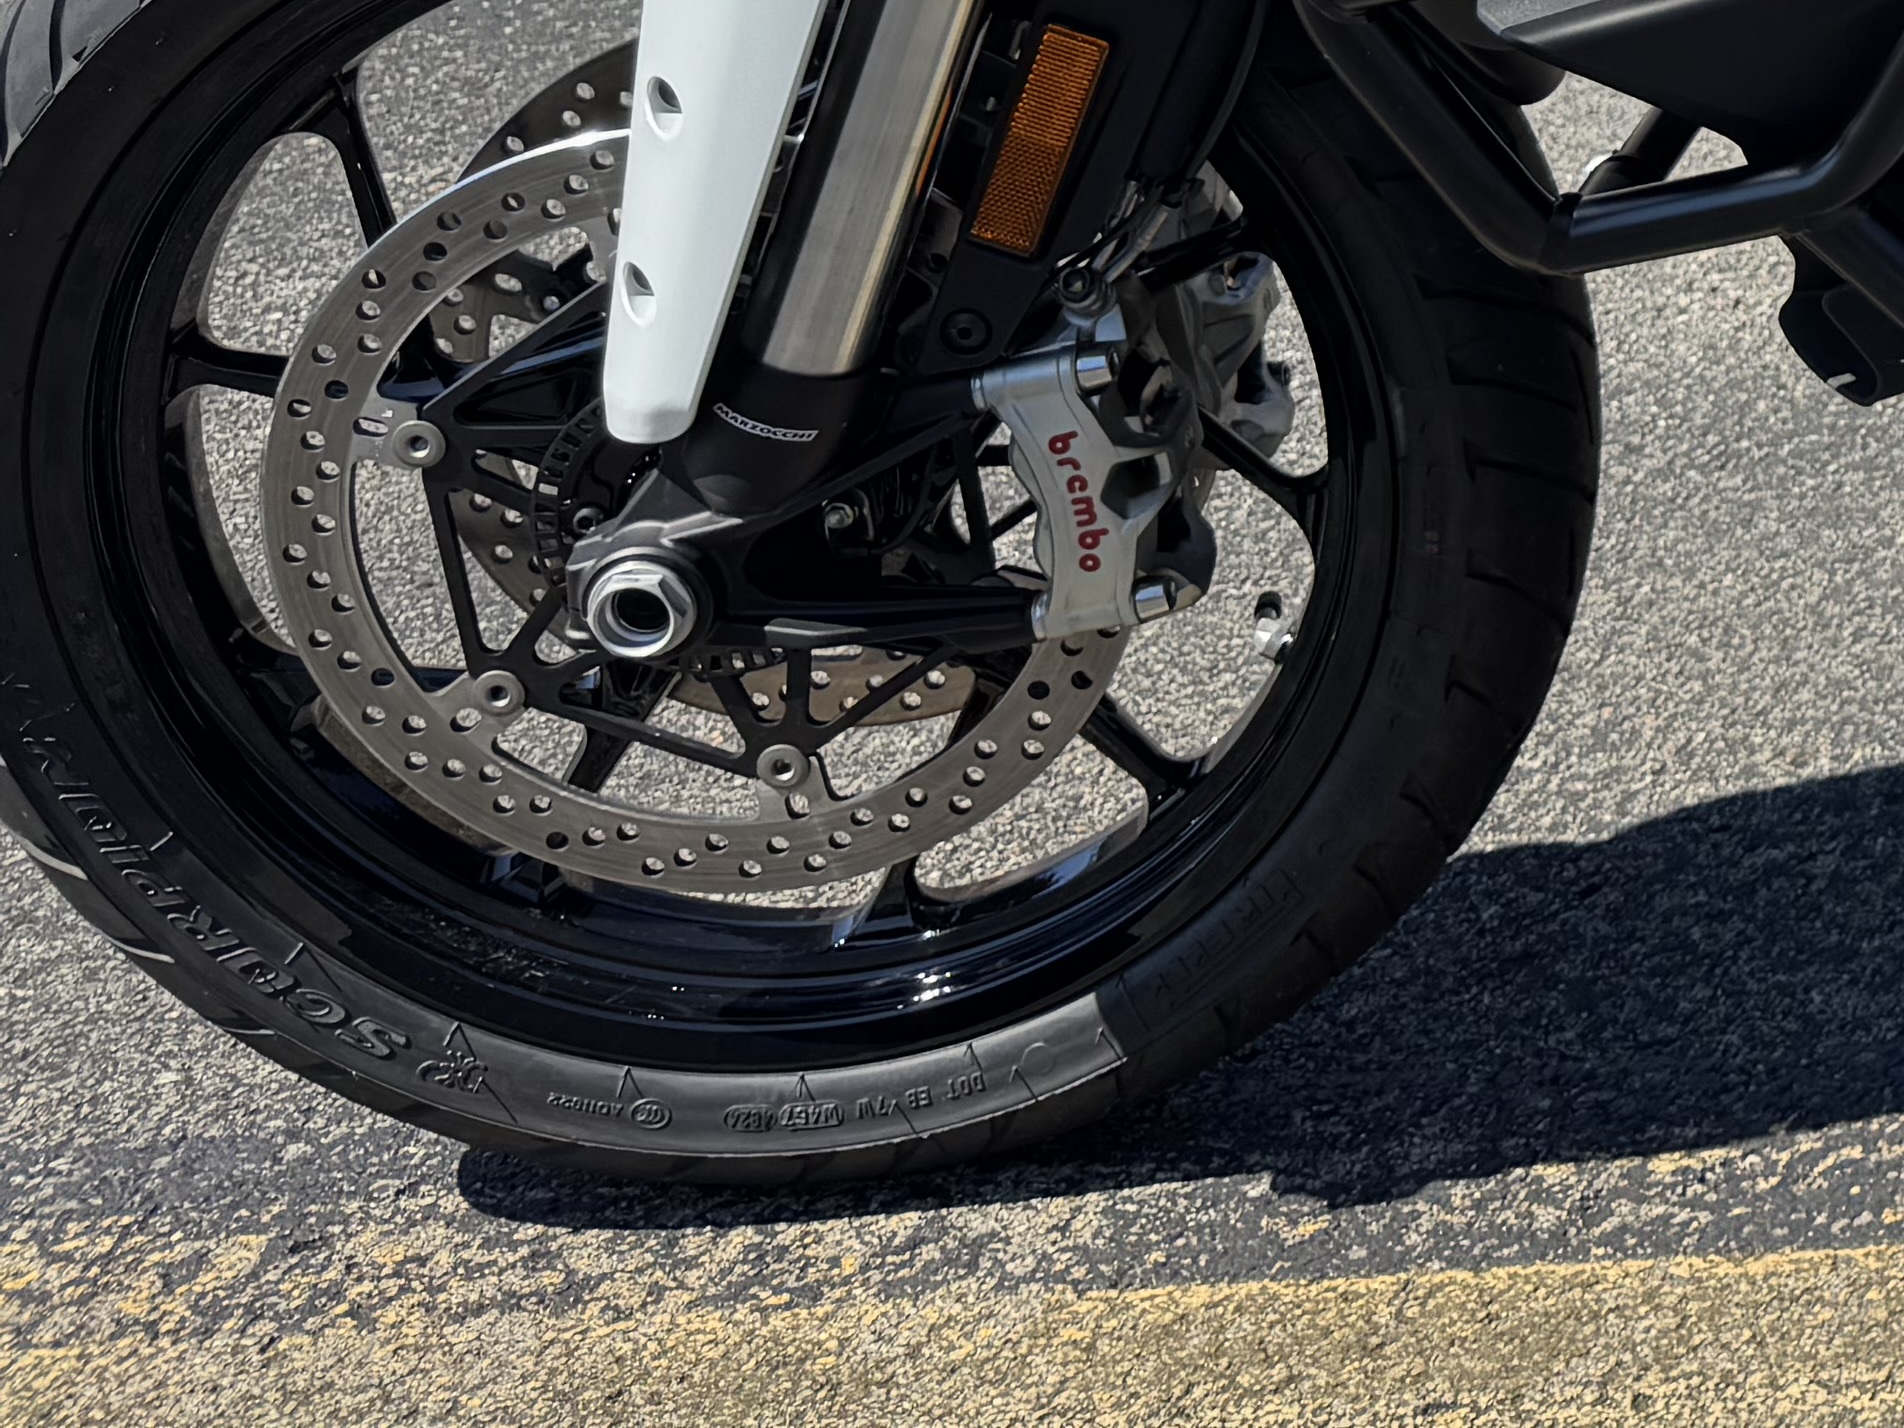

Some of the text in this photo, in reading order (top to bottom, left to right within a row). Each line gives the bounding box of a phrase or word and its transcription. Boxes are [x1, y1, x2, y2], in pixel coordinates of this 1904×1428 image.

[716, 404, 814, 440] MARZOCCHI
[1047, 429, 1110, 573] brembo
[22, 732, 410, 1062] SCORPION
